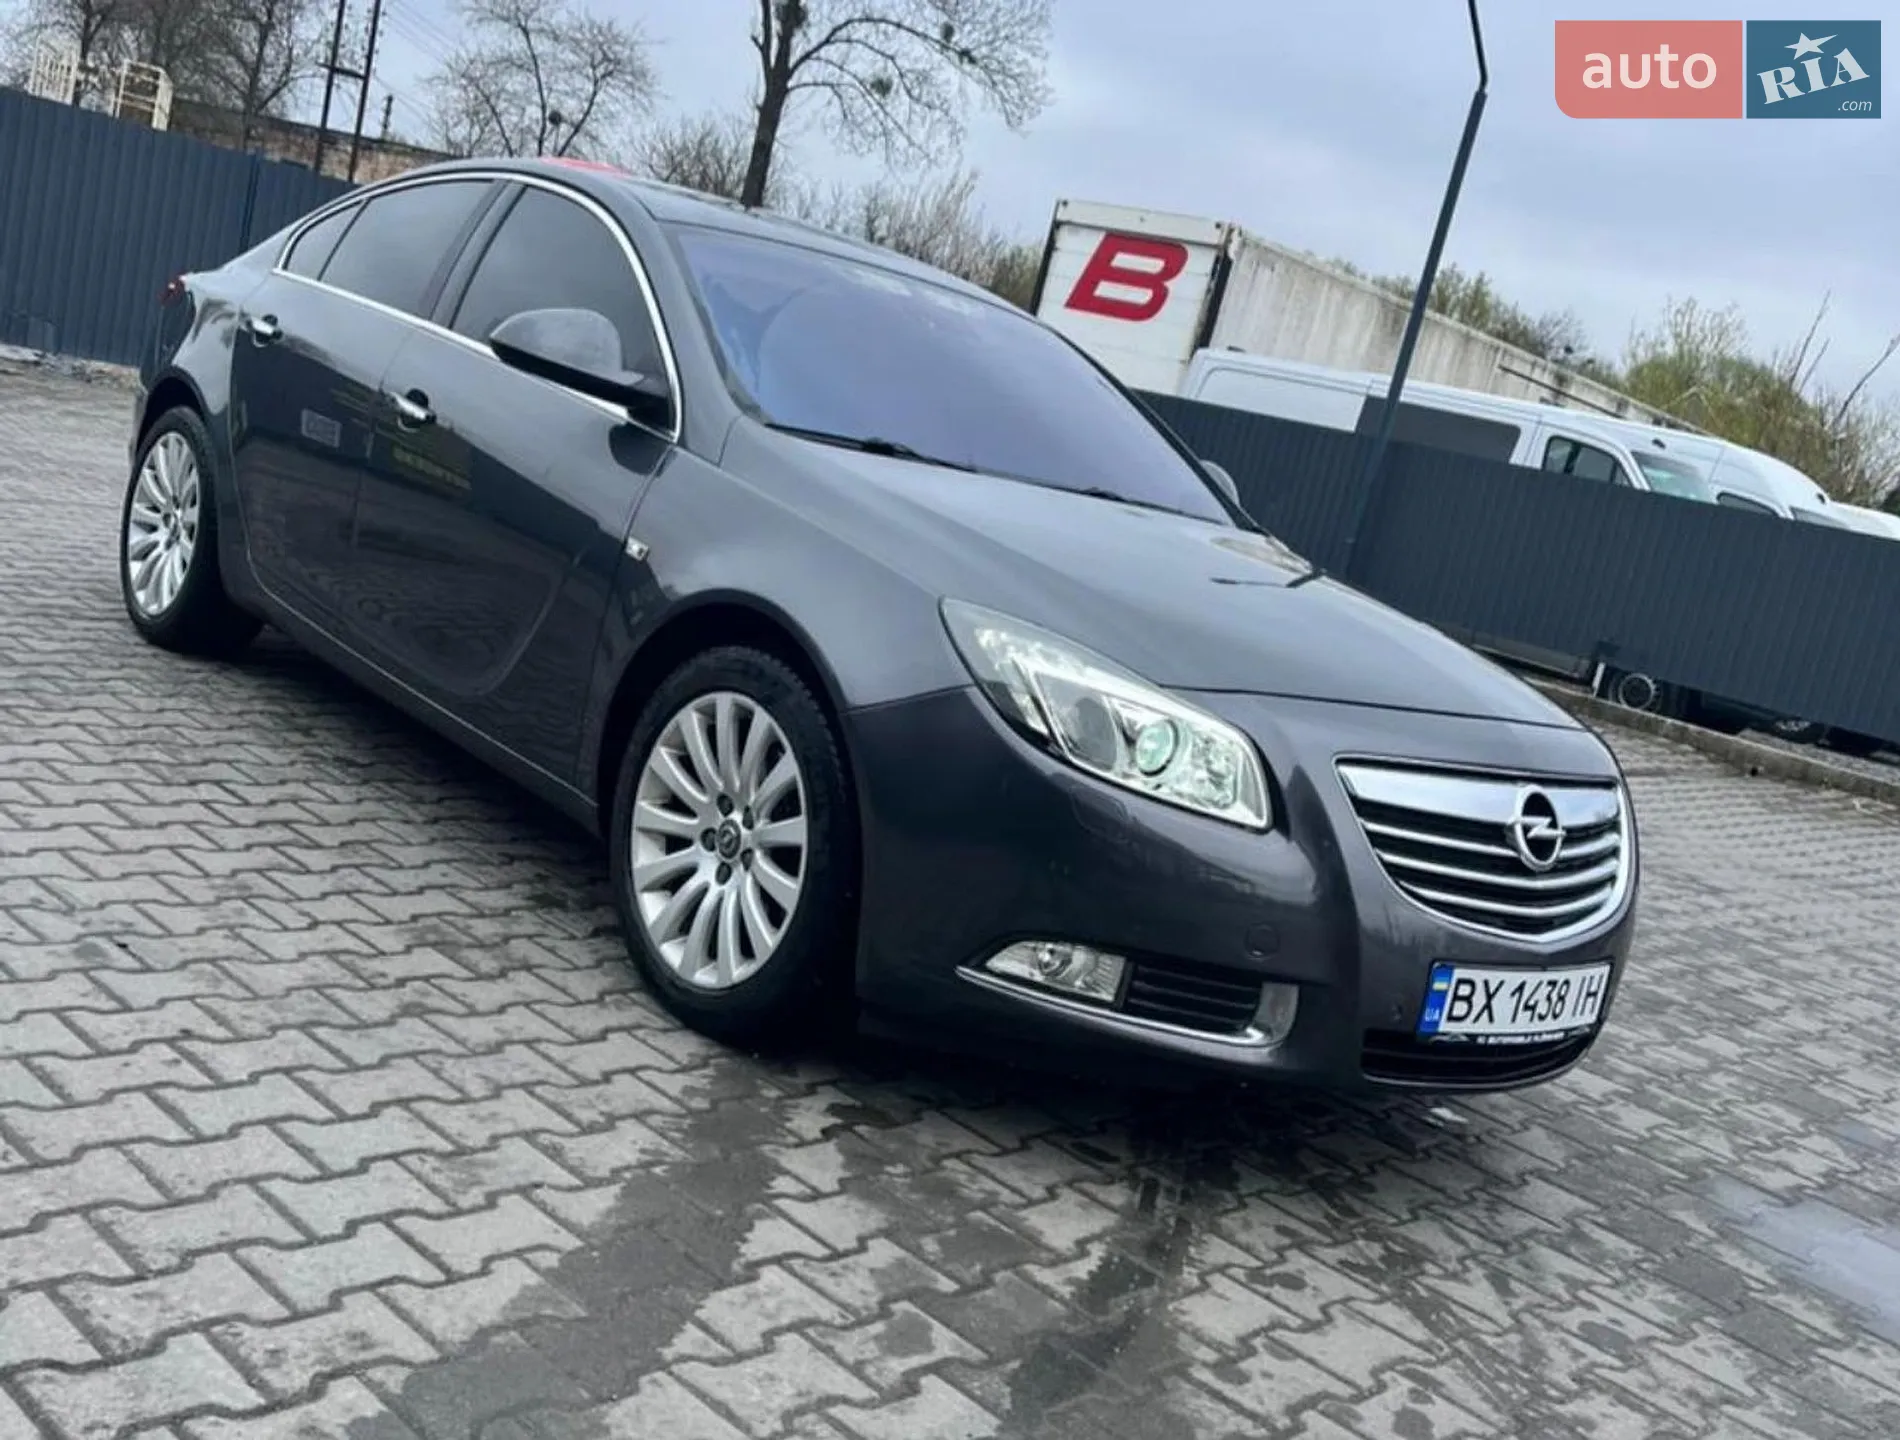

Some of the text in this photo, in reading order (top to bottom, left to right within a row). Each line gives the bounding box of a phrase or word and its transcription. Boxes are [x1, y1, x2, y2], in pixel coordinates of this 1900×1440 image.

[1064, 231, 1189, 322] B
[1446, 974, 1604, 1023] BX 1438 IH
